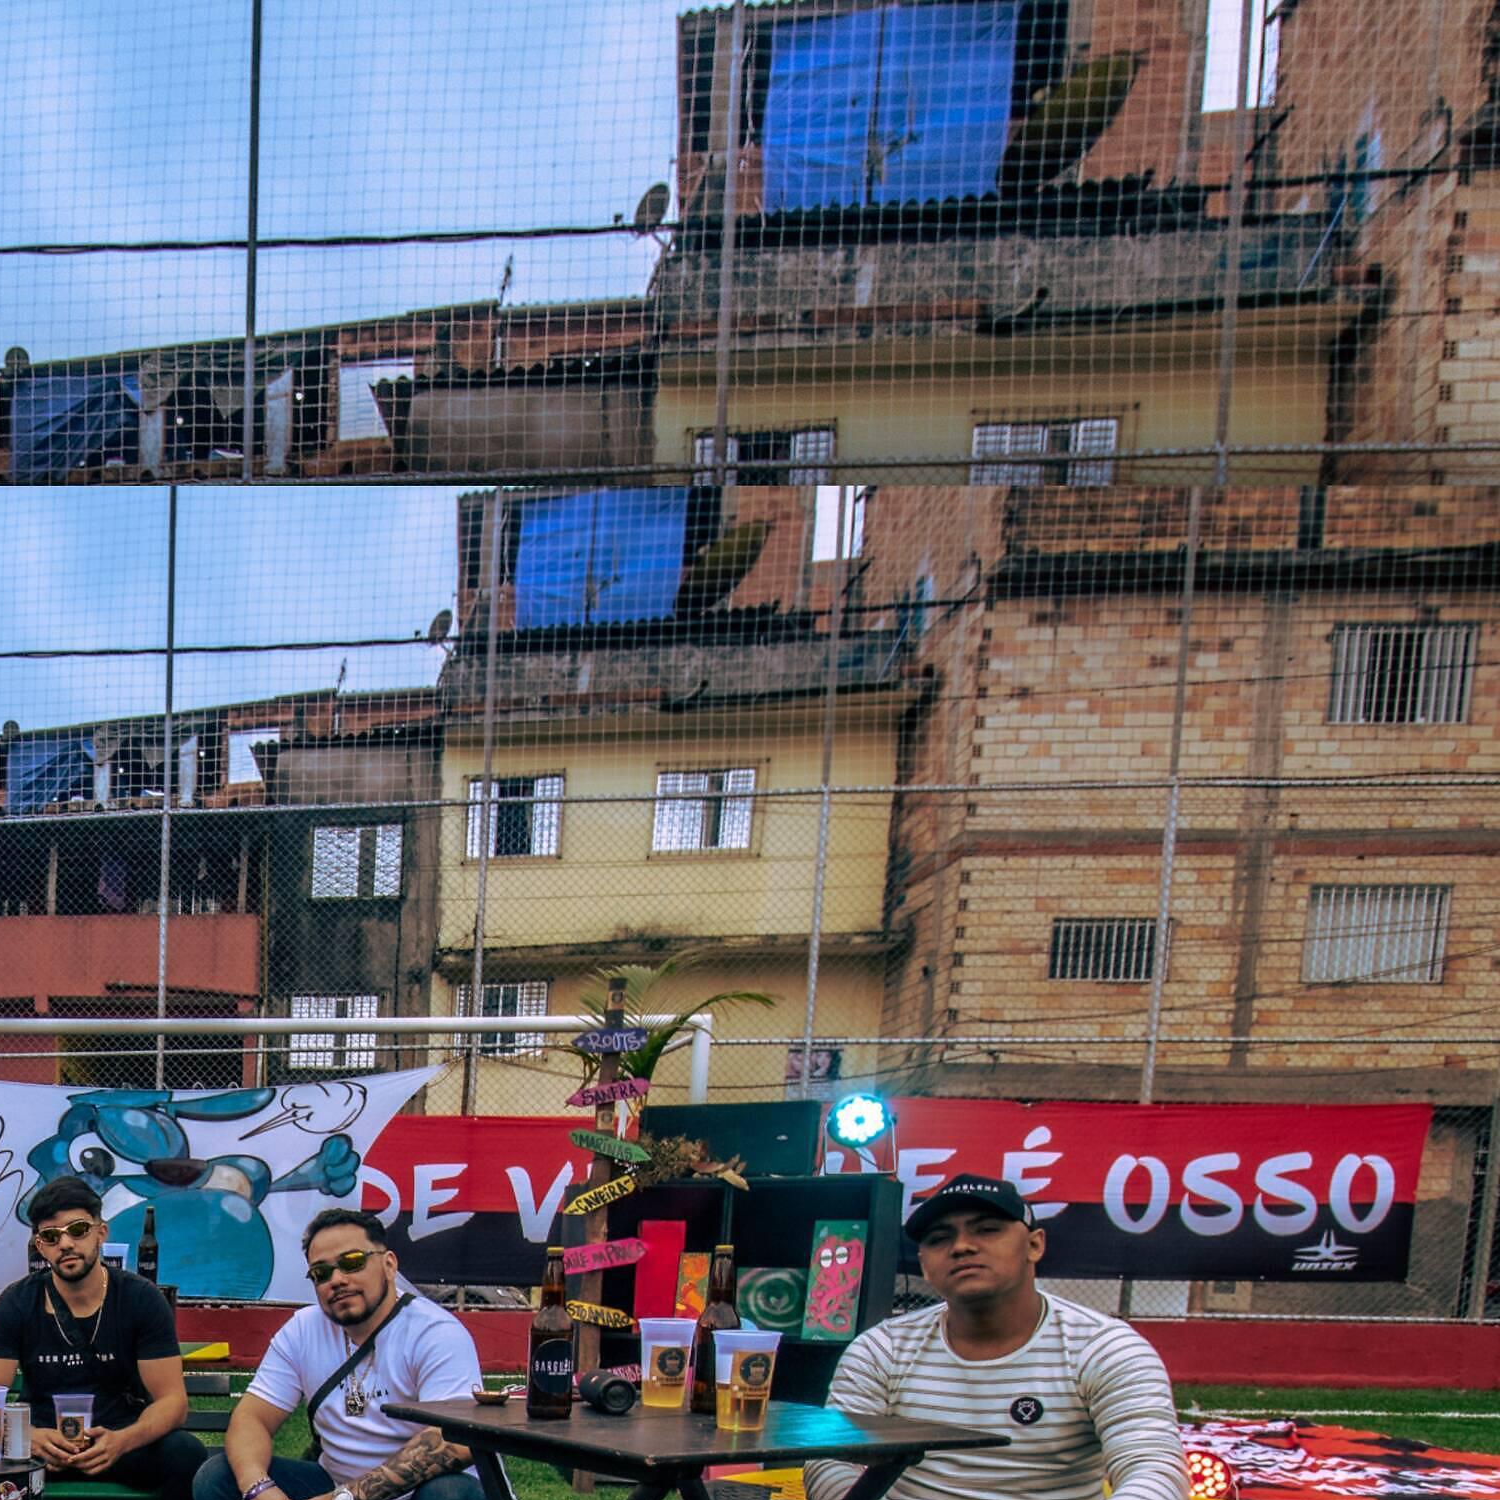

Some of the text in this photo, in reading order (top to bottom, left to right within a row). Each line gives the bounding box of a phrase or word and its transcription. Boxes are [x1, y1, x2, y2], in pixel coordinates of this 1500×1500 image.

[581, 1082, 638, 1106] SANFRA
[353, 1163, 476, 1243] DE
[1103, 1151, 1396, 1237] OSSO
[574, 1179, 629, 1212] CAVEIRA
